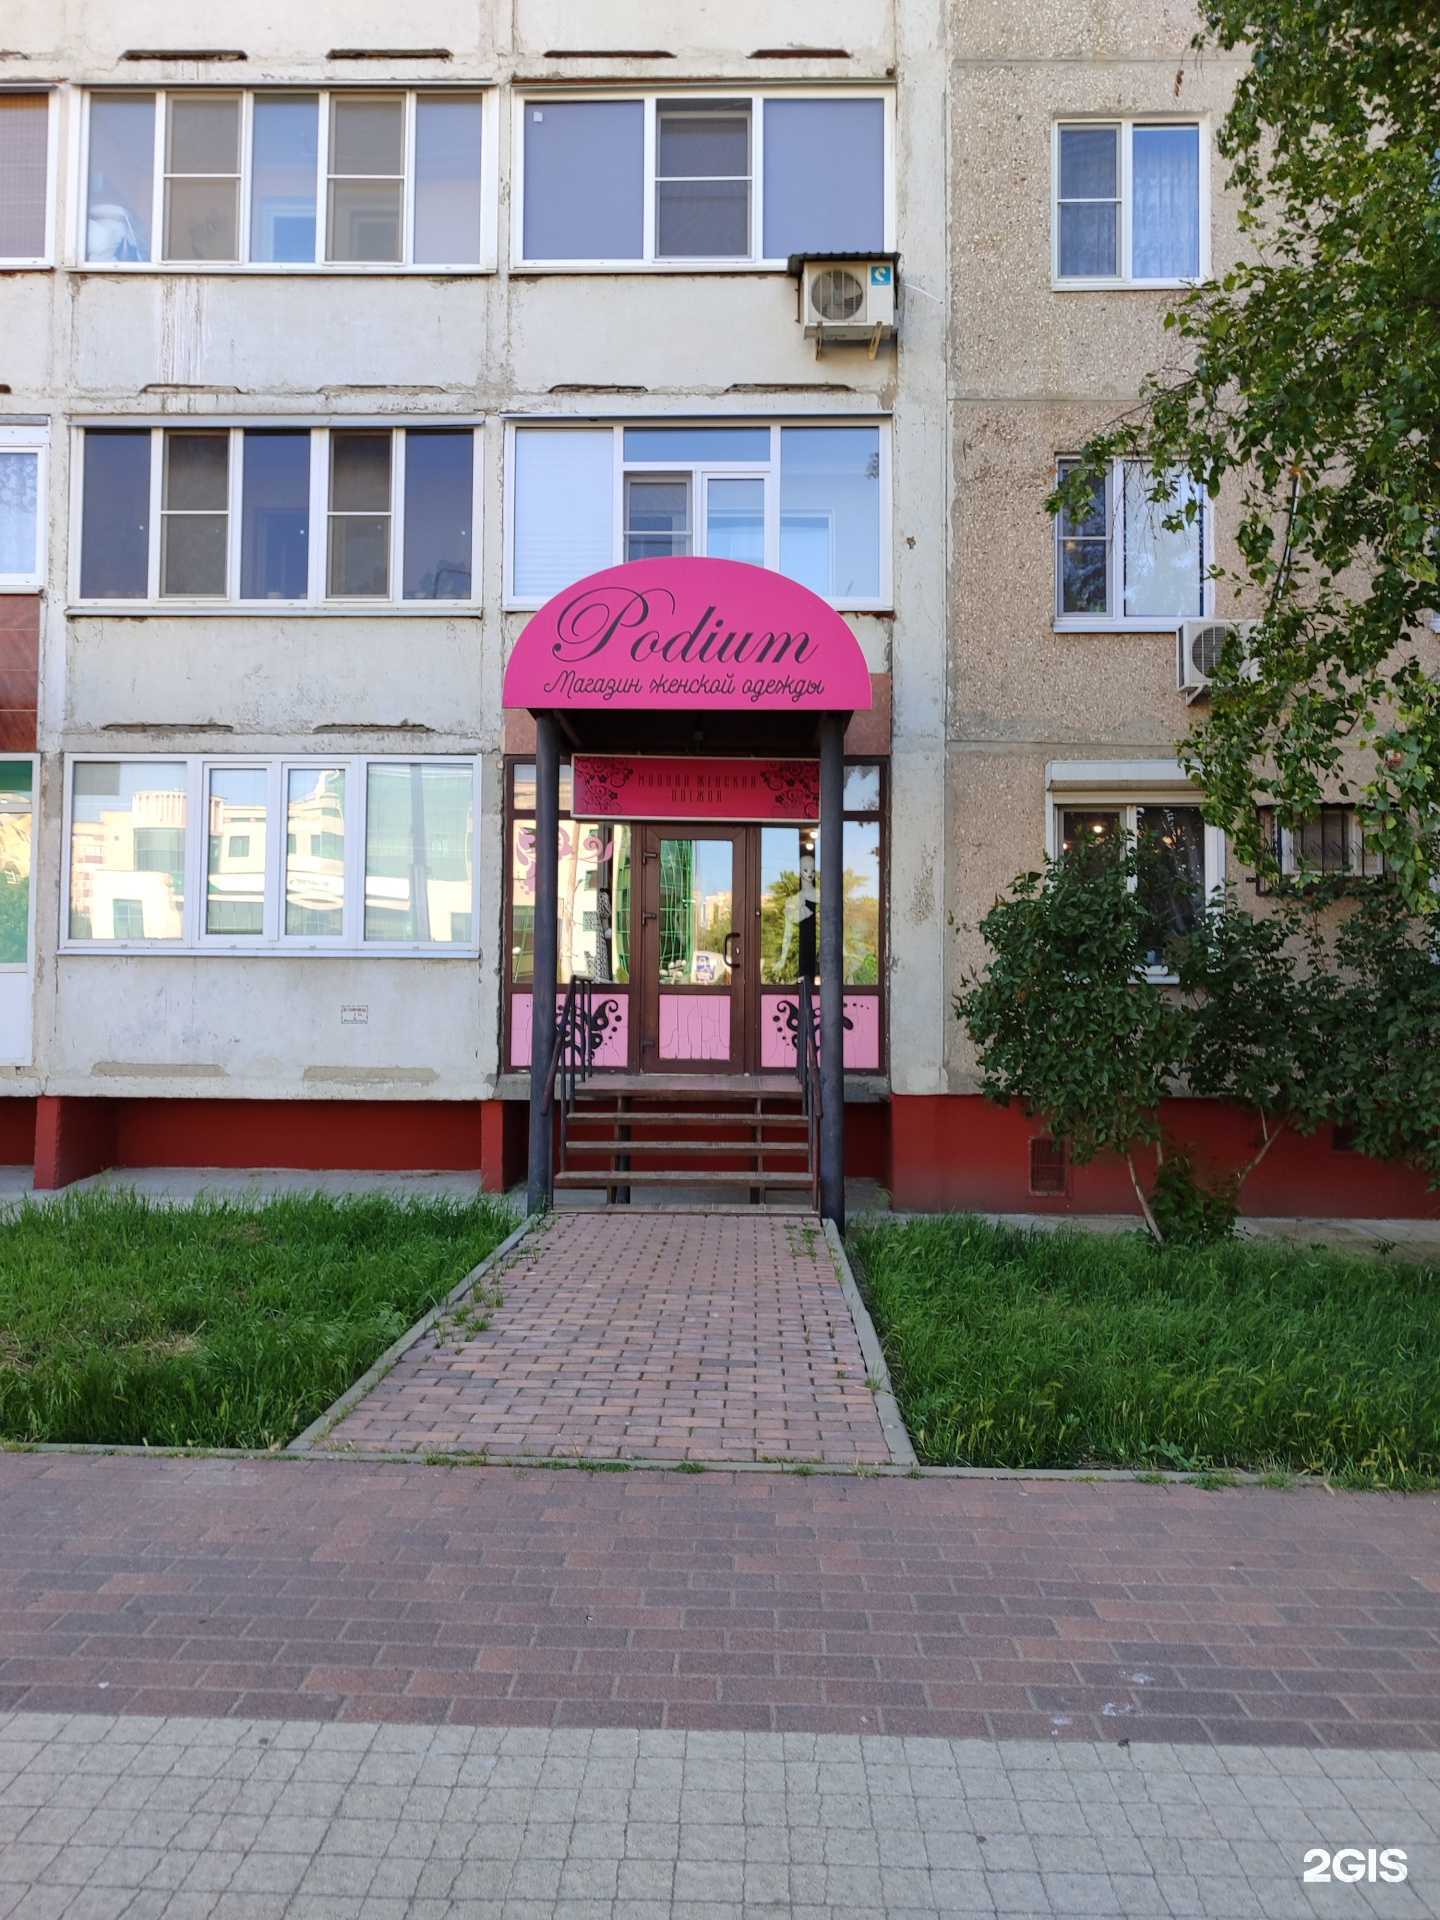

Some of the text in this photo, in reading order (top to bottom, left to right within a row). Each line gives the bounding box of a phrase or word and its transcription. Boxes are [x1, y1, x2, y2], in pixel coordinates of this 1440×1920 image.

[552, 586, 818, 663] Podium
[543, 669, 824, 703] Магазин женской одежды
